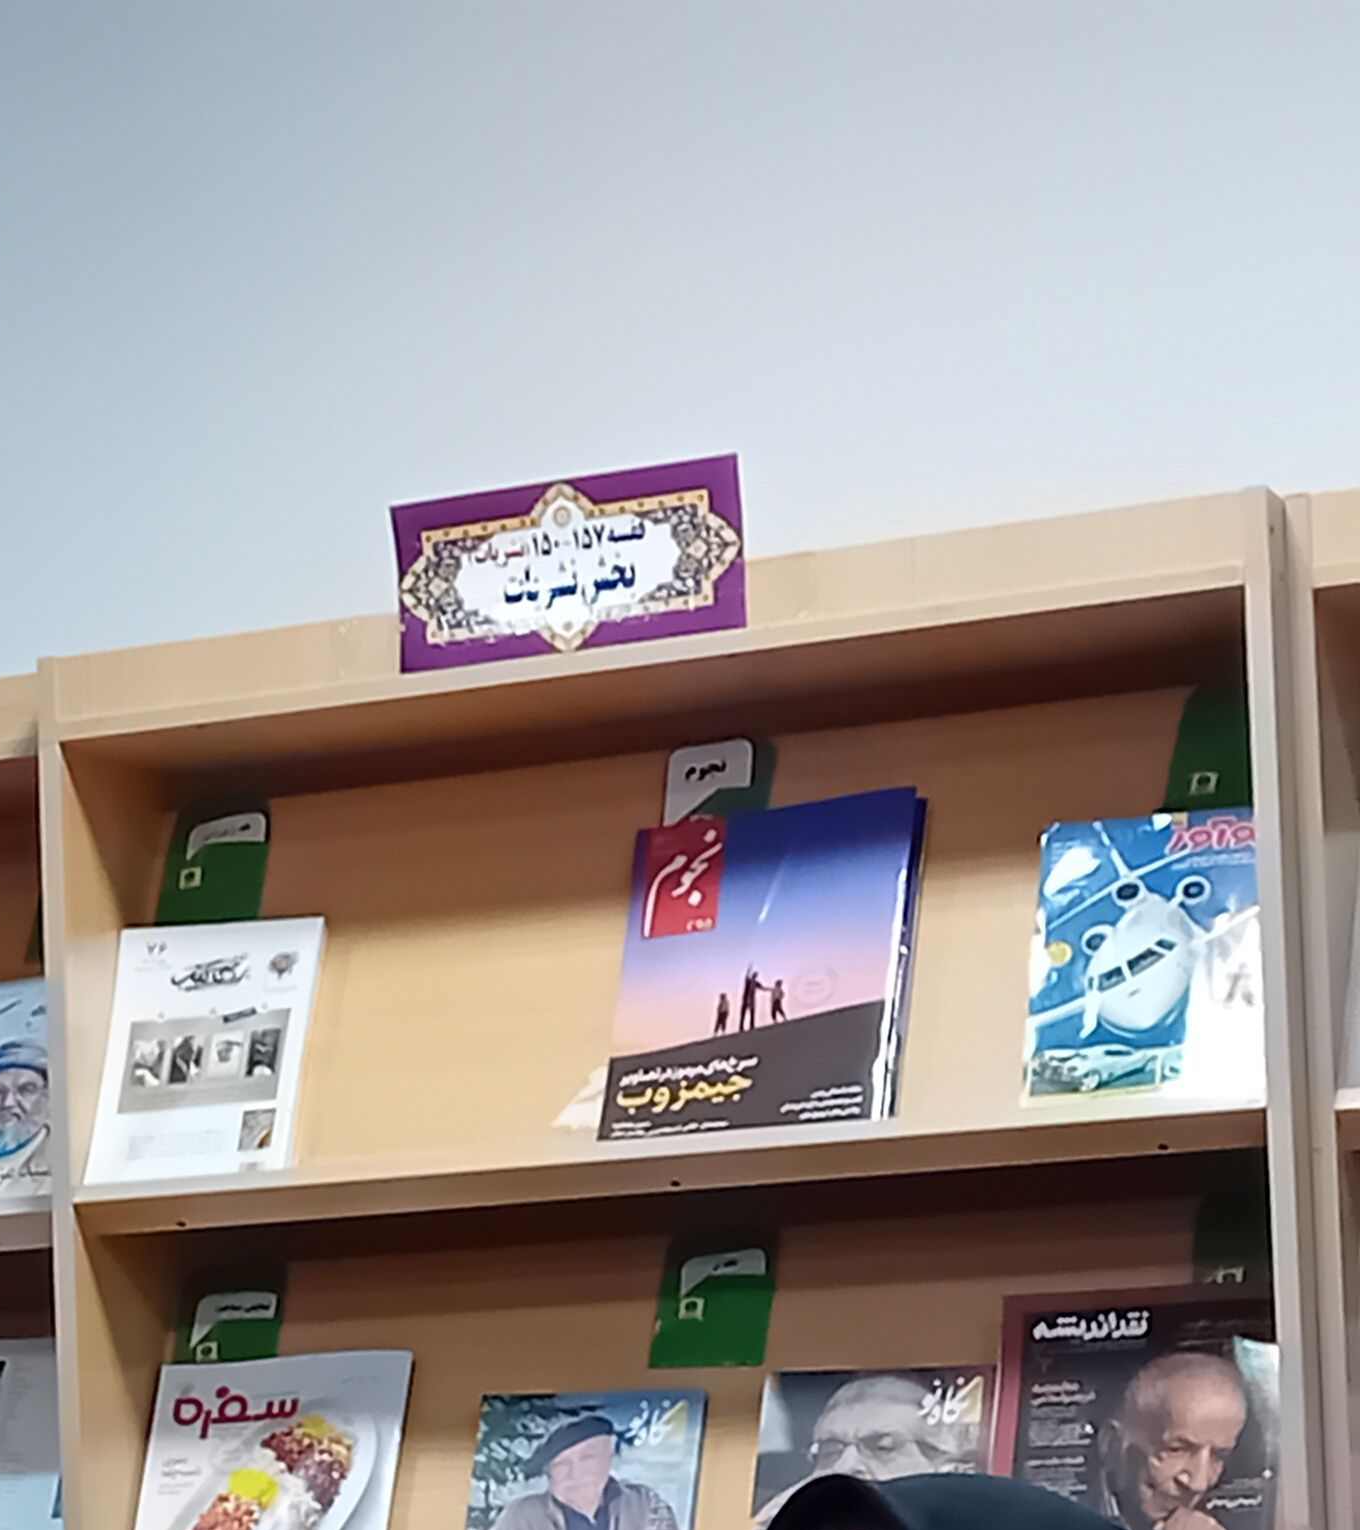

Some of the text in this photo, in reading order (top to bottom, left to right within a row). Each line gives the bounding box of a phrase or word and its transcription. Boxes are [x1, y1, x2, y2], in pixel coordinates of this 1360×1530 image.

[607, 520, 646, 543] قفسه
[504, 552, 636, 610] بخش نشریات
[684, 760, 728, 782] نجوم
[1164, 816, 1256, 852] وآور
[643, 828, 724, 939] نجوم
[615, 1084, 672, 1119] وب
[666, 1071, 755, 1111] جیمز
[1032, 1310, 1151, 1341] نقد اندیشه
[173, 1383, 300, 1440] سفره
